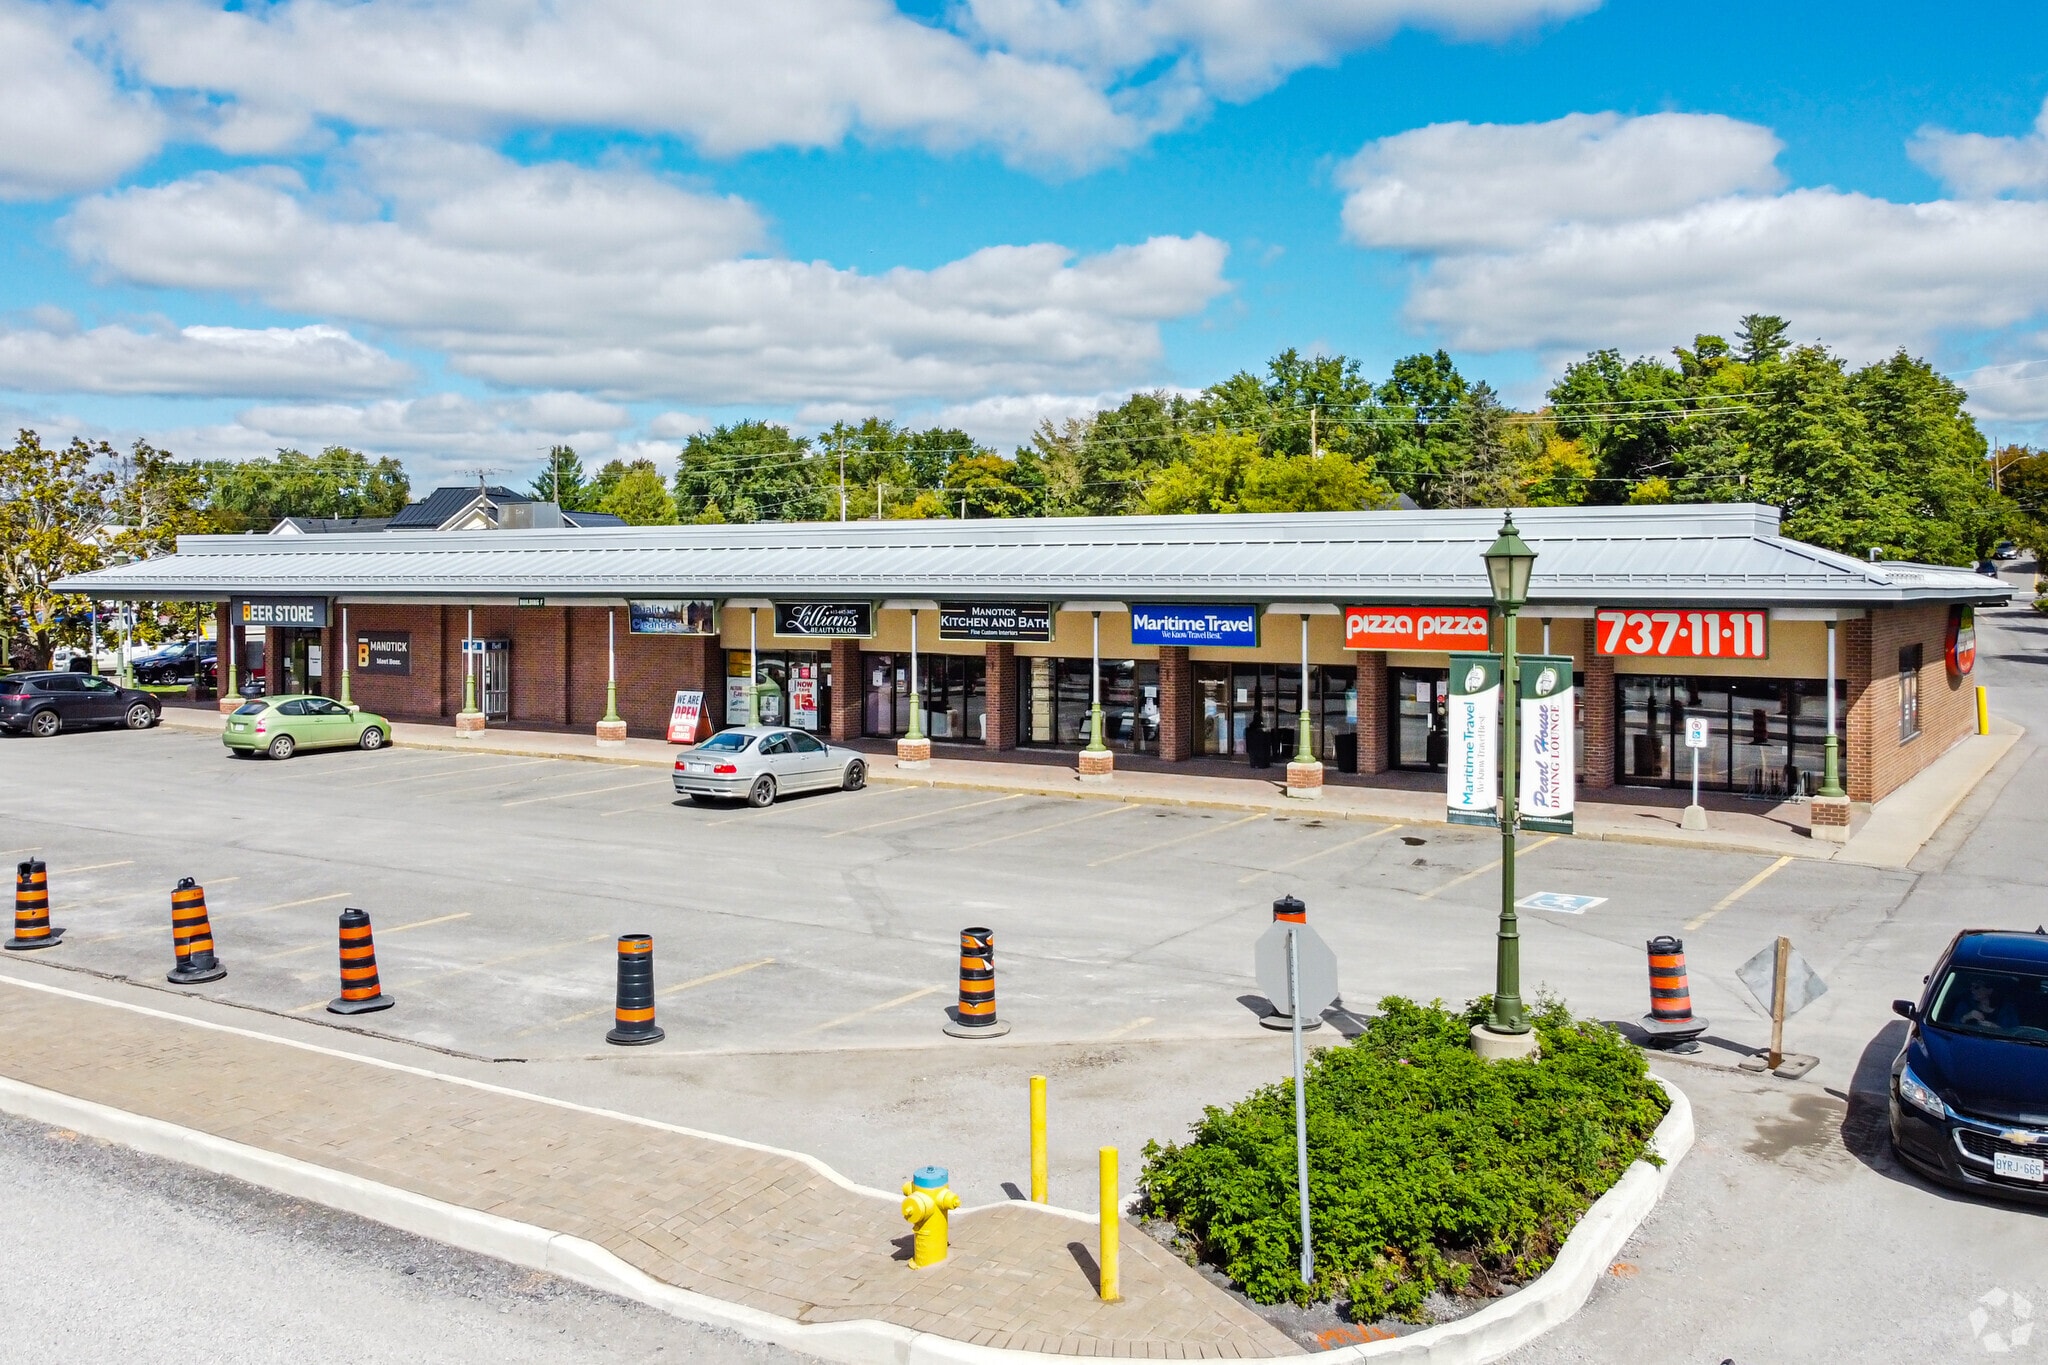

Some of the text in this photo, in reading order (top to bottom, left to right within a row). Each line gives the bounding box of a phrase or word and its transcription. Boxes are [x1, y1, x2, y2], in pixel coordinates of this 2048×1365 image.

[243, 604, 314, 622] BEER STORE
[632, 604, 668, 615] Quality
[972, 607, 1017, 616] MANOTICK
[632, 618, 677, 630] Cleaners
[786, 605, 859, 633] Lillians
[941, 615, 1049, 628] KITCHEN AND BATH
[1133, 614, 1253, 632] Maritime Travel
[1346, 614, 1488, 641] pizza pizza
[1162, 630, 1171, 638] We
[1187, 631, 1206, 639] Travel
[370, 641, 408, 652] MANOTICK
[677, 694, 701, 705] WE ARE
[674, 706, 698, 719] OPEN
[1463, 701, 1475, 805] Maritime Travel
[1533, 704, 1549, 808] Pearl House
[1550, 704, 1560, 809] DINING LOUNGE
